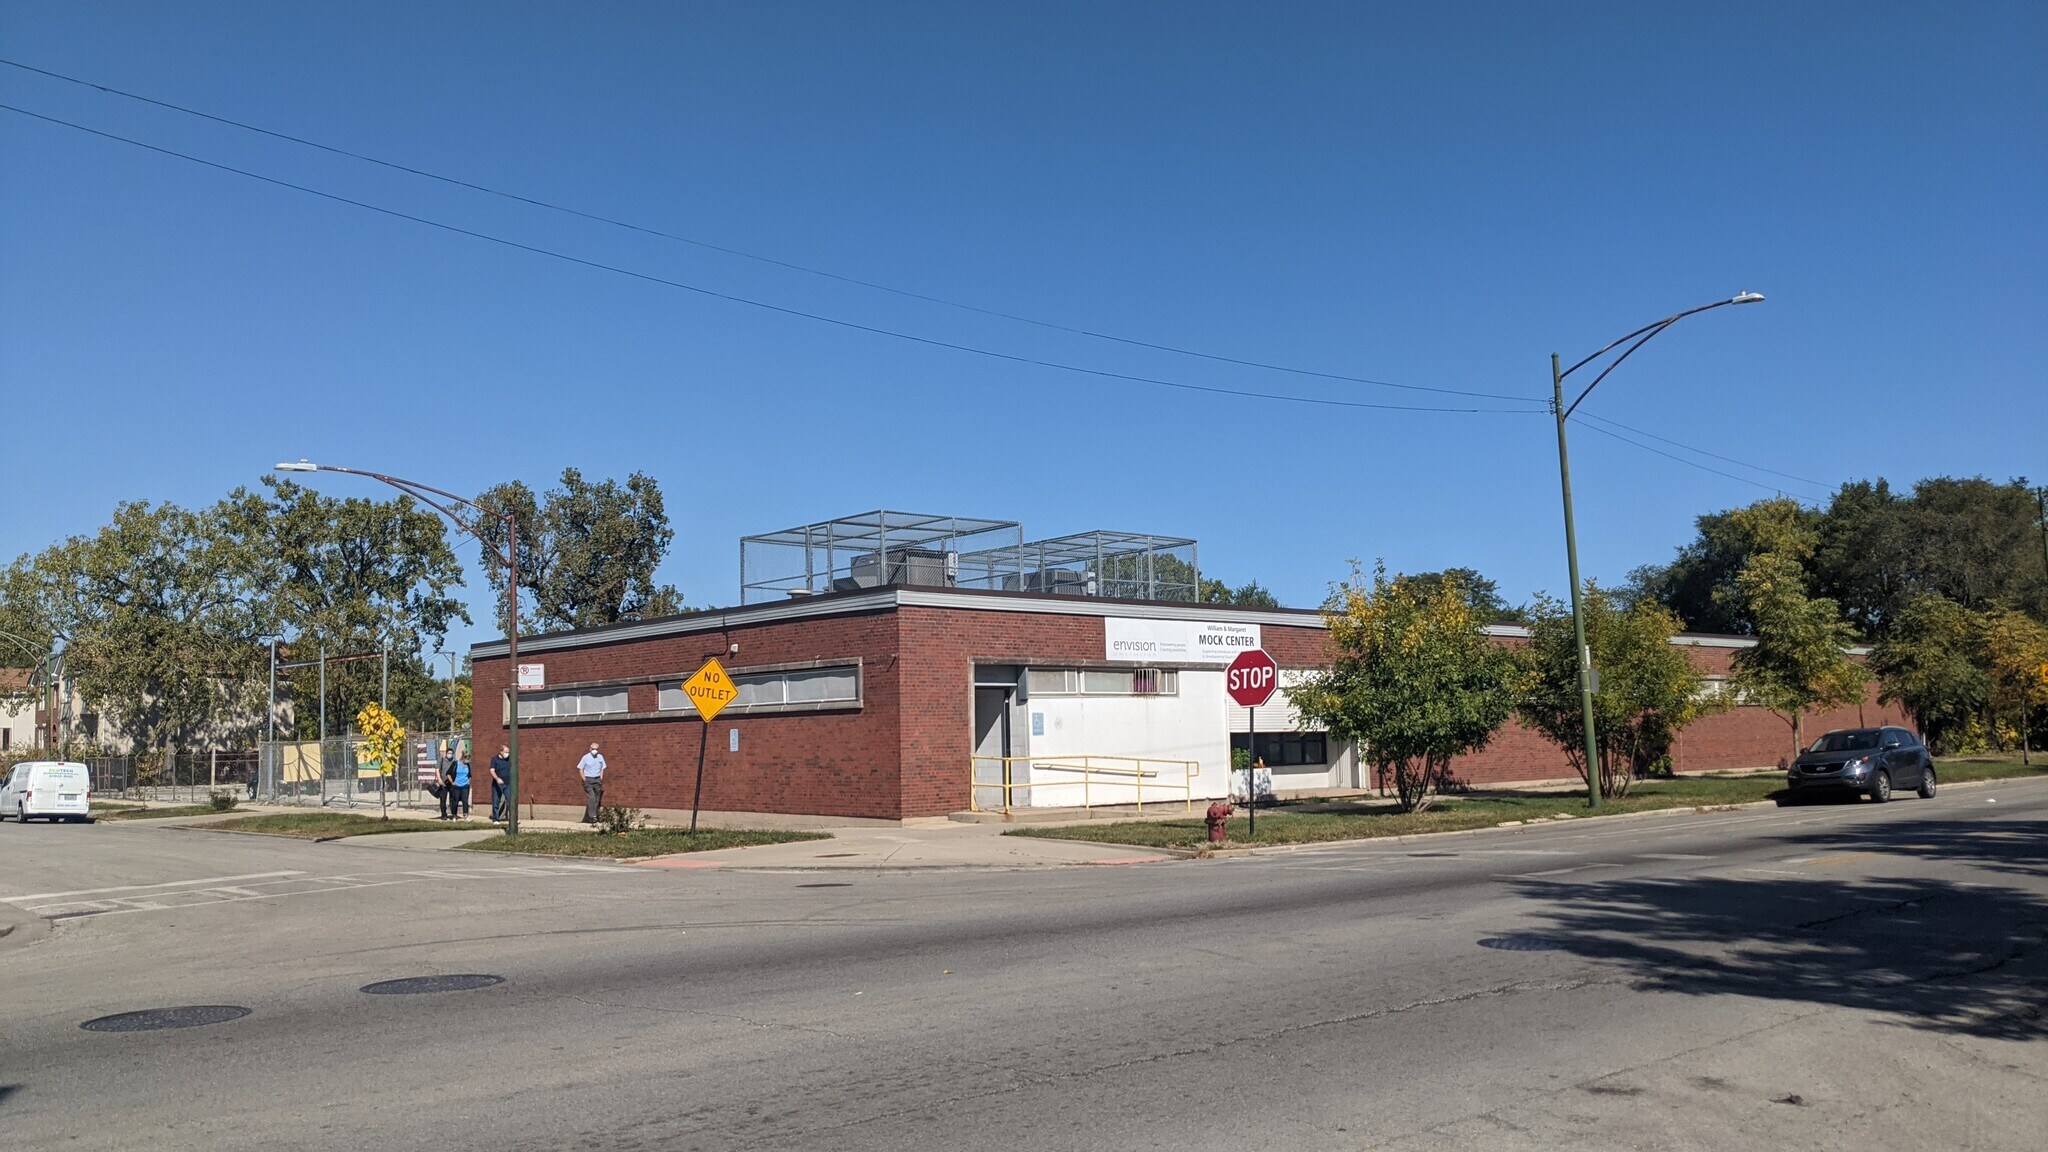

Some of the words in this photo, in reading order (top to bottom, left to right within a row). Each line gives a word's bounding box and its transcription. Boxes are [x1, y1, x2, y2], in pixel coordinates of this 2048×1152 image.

[1114, 640, 1156, 651] envision
[1198, 634, 1224, 646] MOCK
[1226, 636, 1254, 646] CENTER
[704, 672, 720, 683] NO
[1230, 666, 1273, 690] STOP
[690, 686, 730, 700] OUTLET
